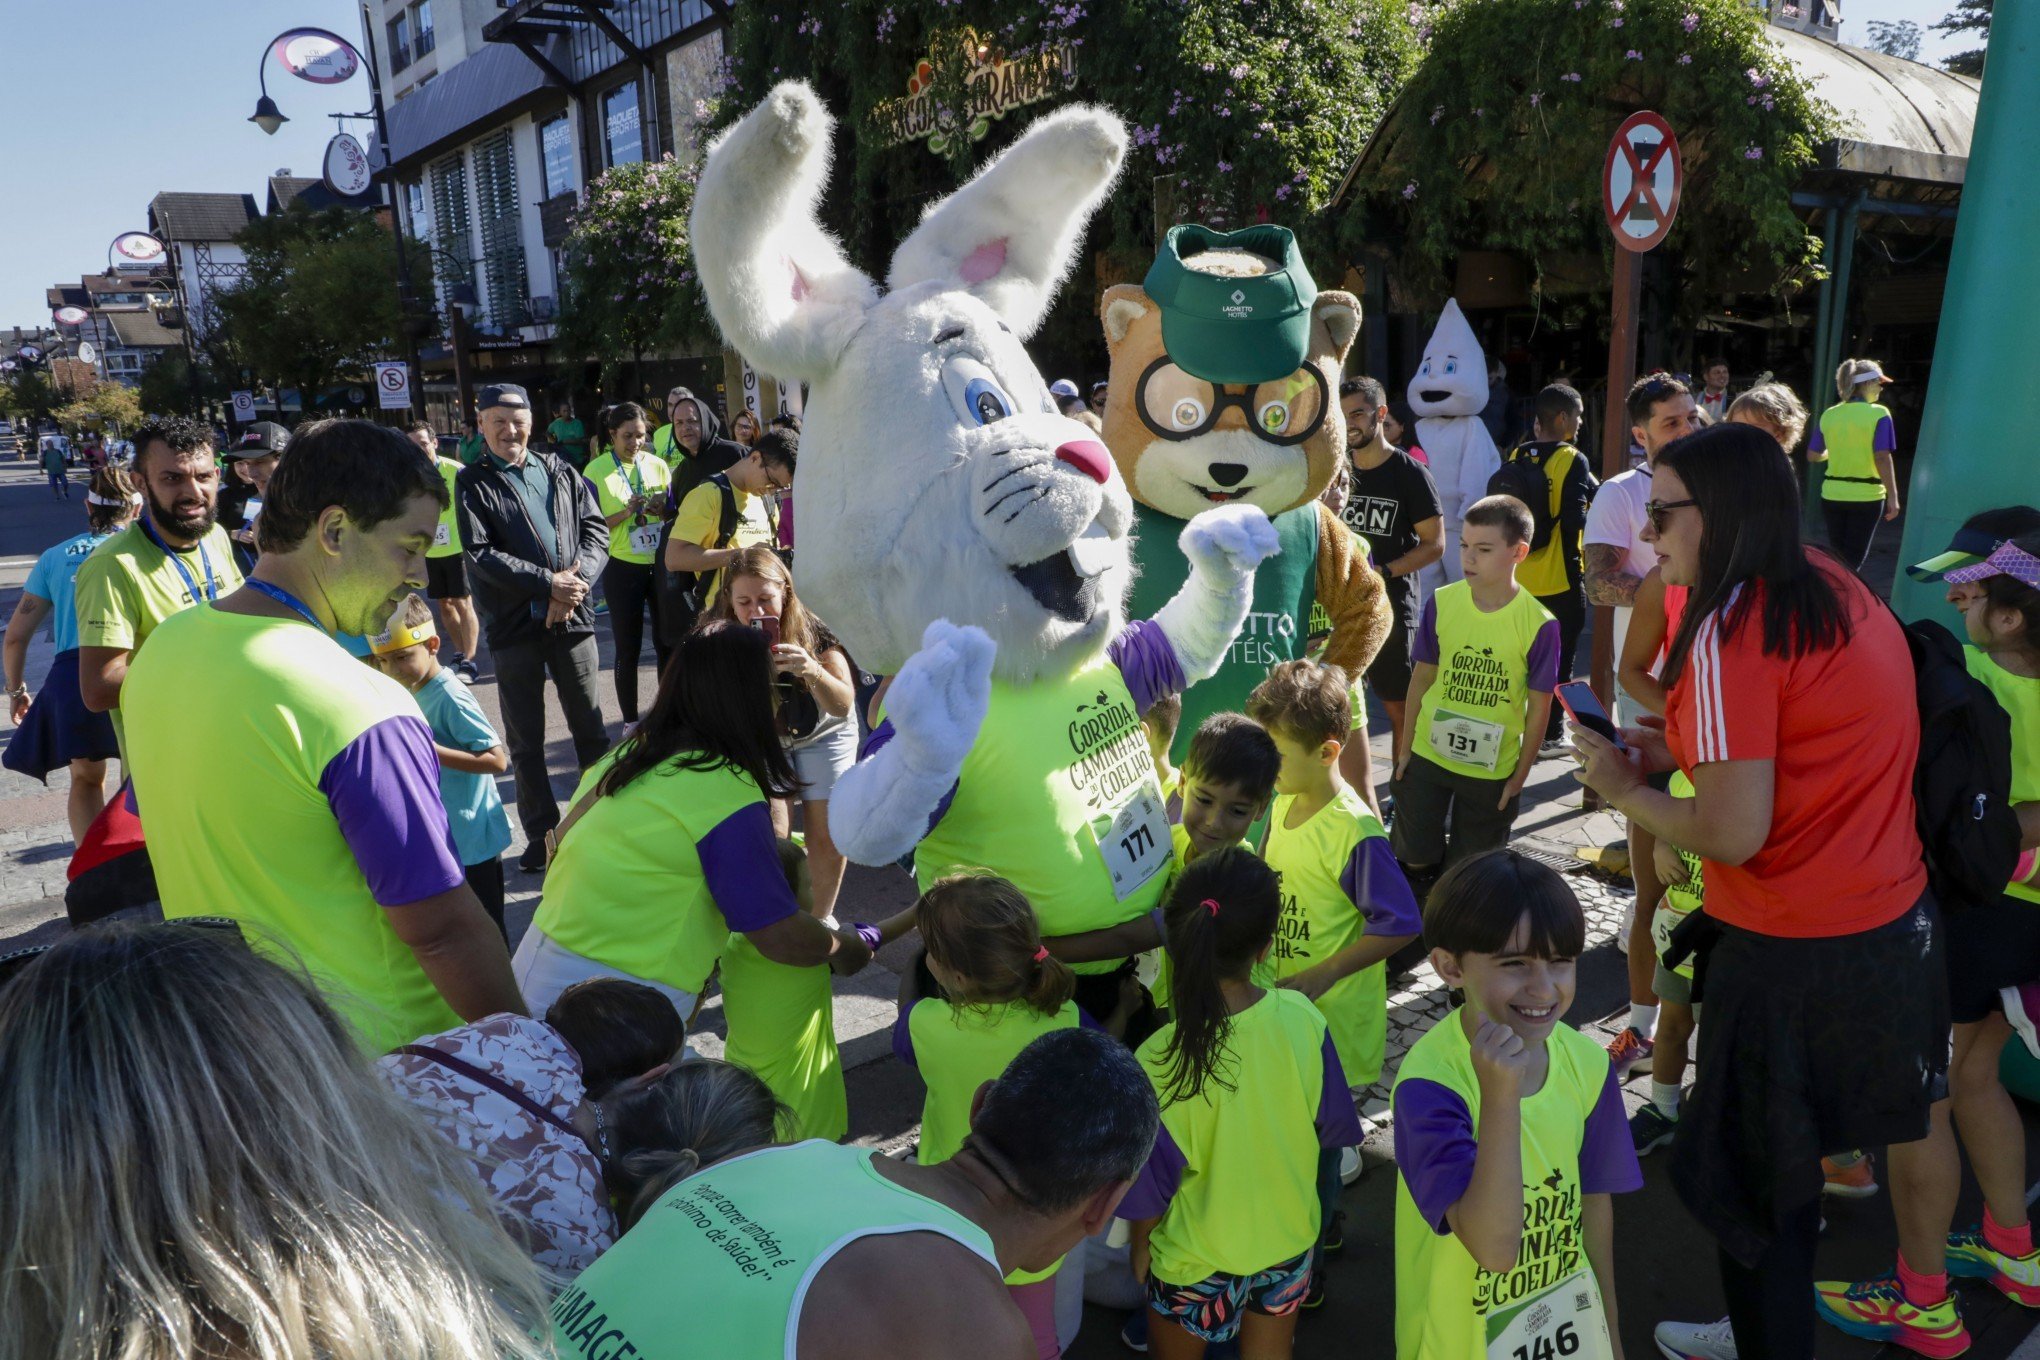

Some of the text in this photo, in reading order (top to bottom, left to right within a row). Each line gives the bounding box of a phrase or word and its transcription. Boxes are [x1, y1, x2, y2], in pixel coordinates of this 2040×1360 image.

[1342, 506, 1390, 529] Co N
[1247, 611, 1295, 637] TTO
[1232, 637, 1276, 664] TÉIS
[1452, 651, 1503, 676] CORRIDA
[1448, 685, 1498, 707] COELHO
[1068, 702, 1132, 755] CORRIDA
[1069, 722, 1146, 791] CAMINHAD
[1447, 732, 1477, 754] 131
[1099, 748, 1150, 801] COELHO
[1120, 823, 1155, 864] 171
[1277, 915, 1311, 942] ADA
[705, 1229, 728, 1244] de
[715, 1199, 749, 1229] correr
[741, 1217, 783, 1260] também
[772, 1259, 796, 1269] é
